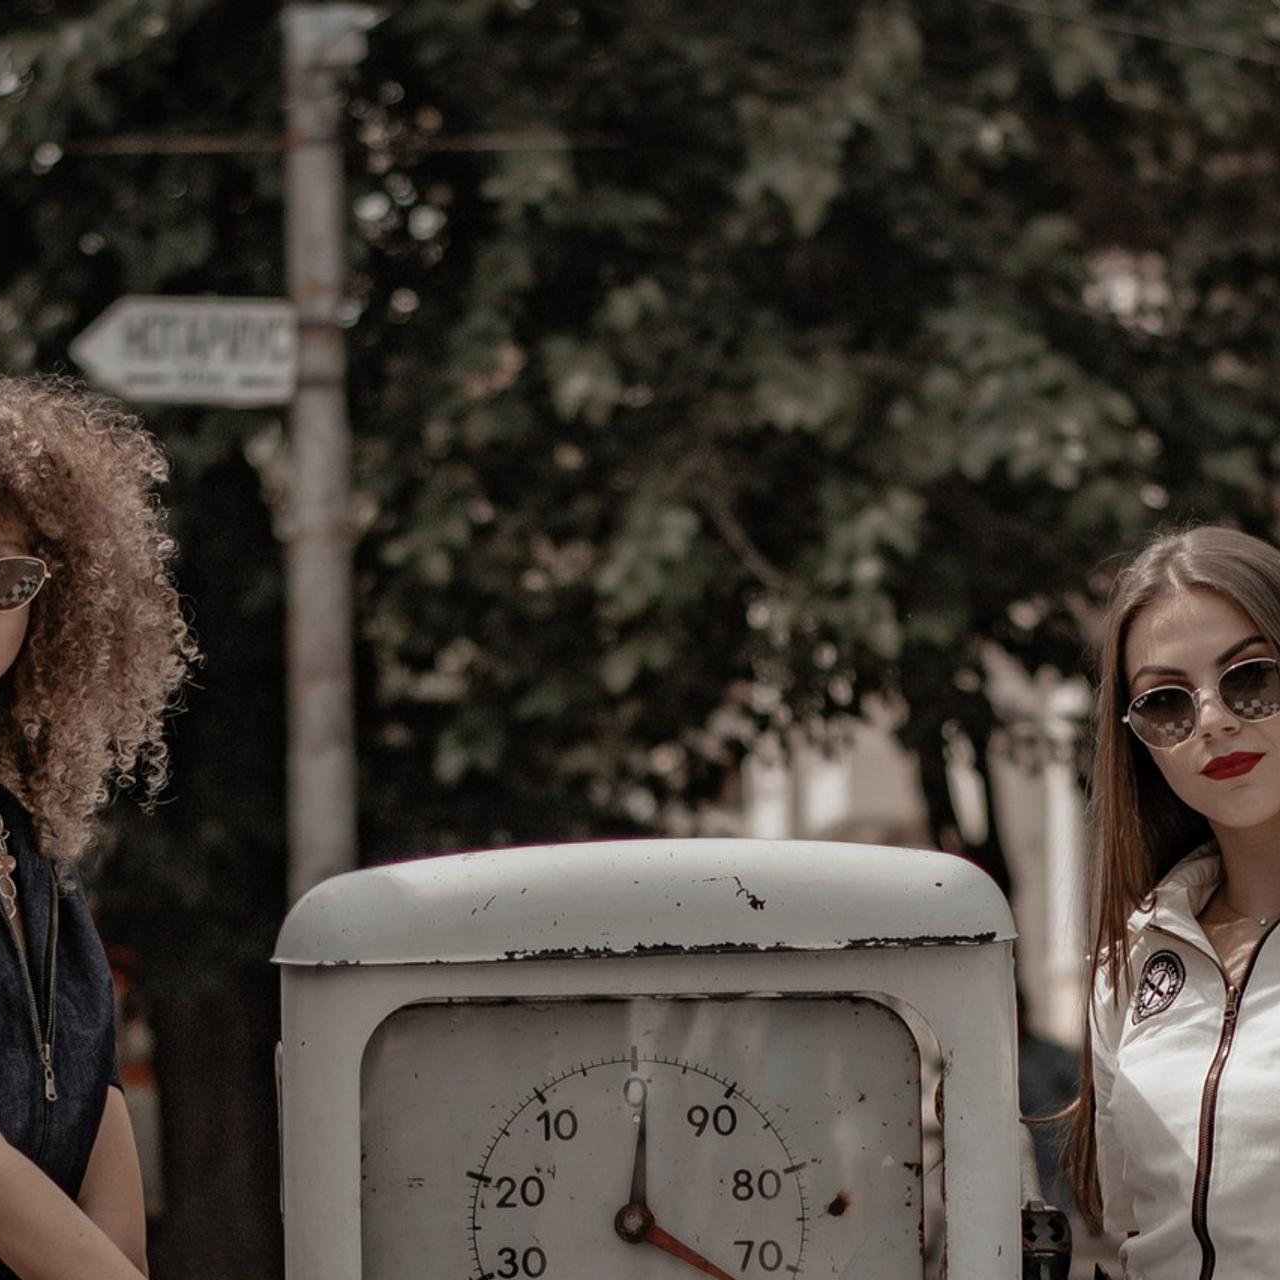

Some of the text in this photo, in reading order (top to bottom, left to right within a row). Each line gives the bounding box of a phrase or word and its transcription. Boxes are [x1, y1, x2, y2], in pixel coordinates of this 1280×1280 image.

[536, 1108, 579, 1142] 10
[686, 1104, 738, 1138] 90
[495, 1175, 546, 1209] 20
[731, 1168, 783, 1202] 80
[495, 1246, 548, 1279] 30
[733, 1239, 784, 1273] 70
